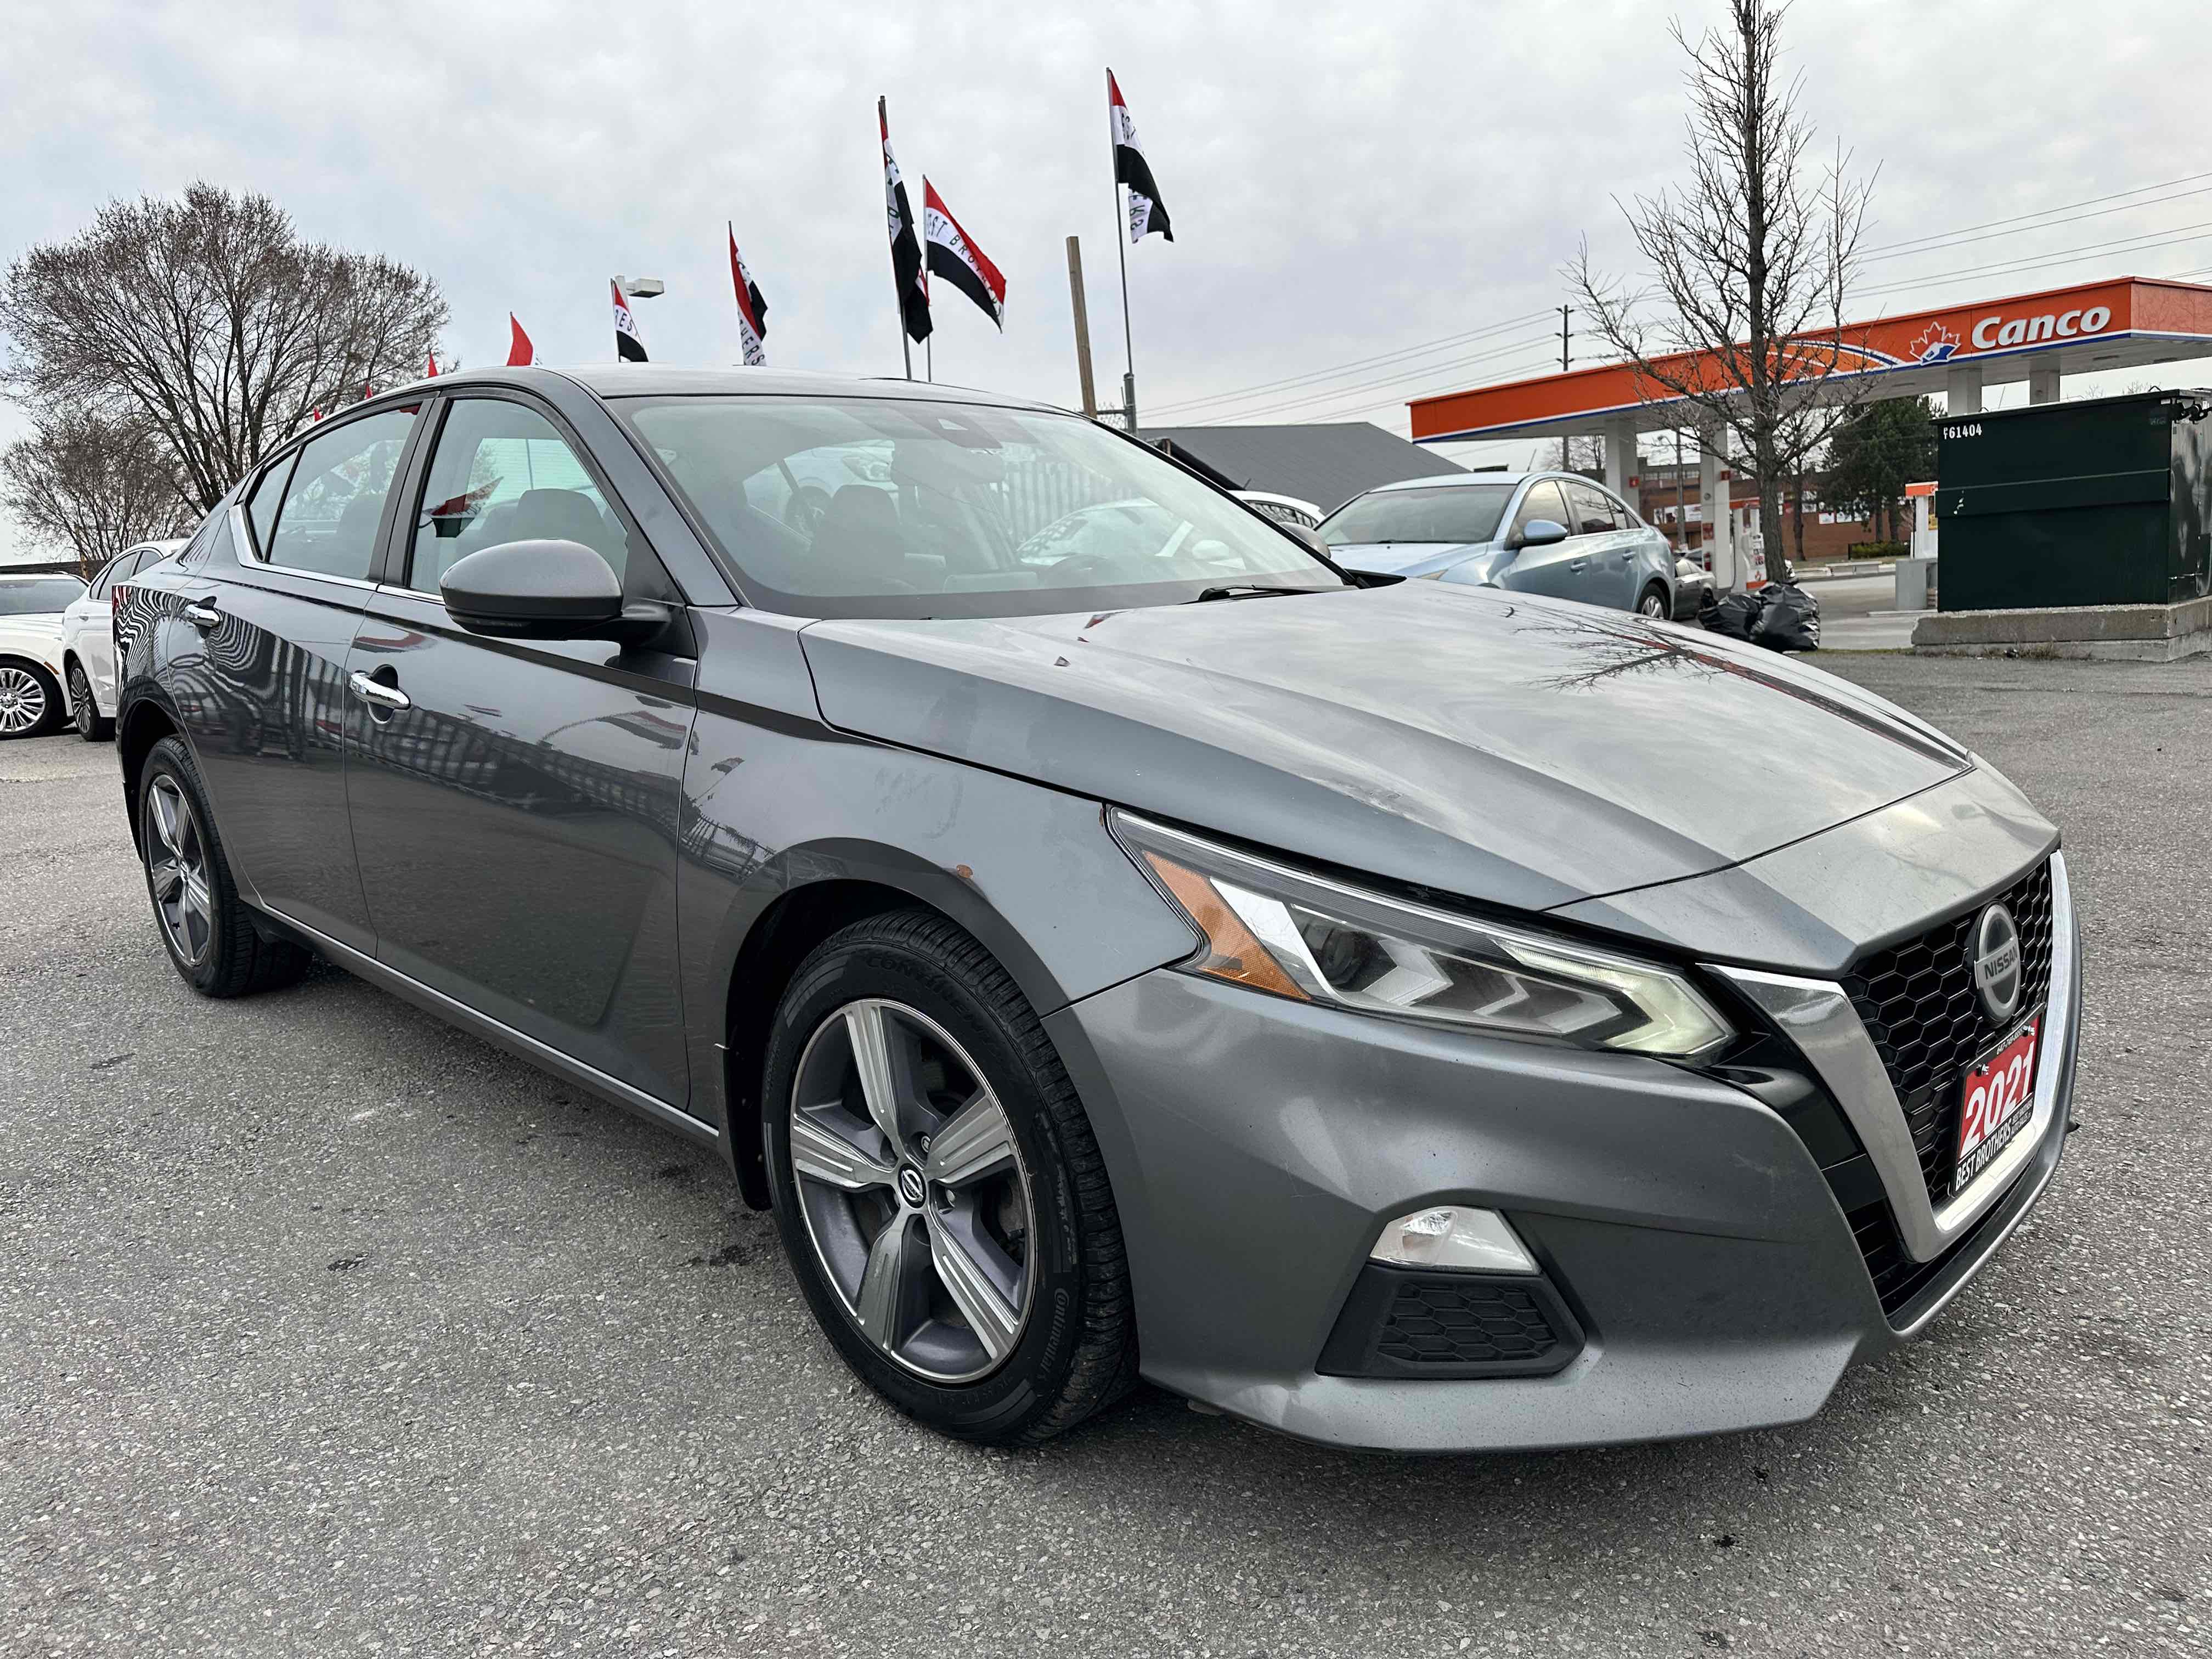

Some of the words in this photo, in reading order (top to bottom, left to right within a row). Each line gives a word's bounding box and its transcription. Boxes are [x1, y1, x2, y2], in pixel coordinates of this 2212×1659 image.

[1972, 306, 2111, 349] Canco
[1984, 945, 2018, 980] NISSAN
[1960, 1041, 2035, 1158] 2021
[1955, 1154, 1976, 1191] BEST
[1975, 1118, 2012, 1173] BROTHERS
[1040, 1288, 1069, 1373] Continental
